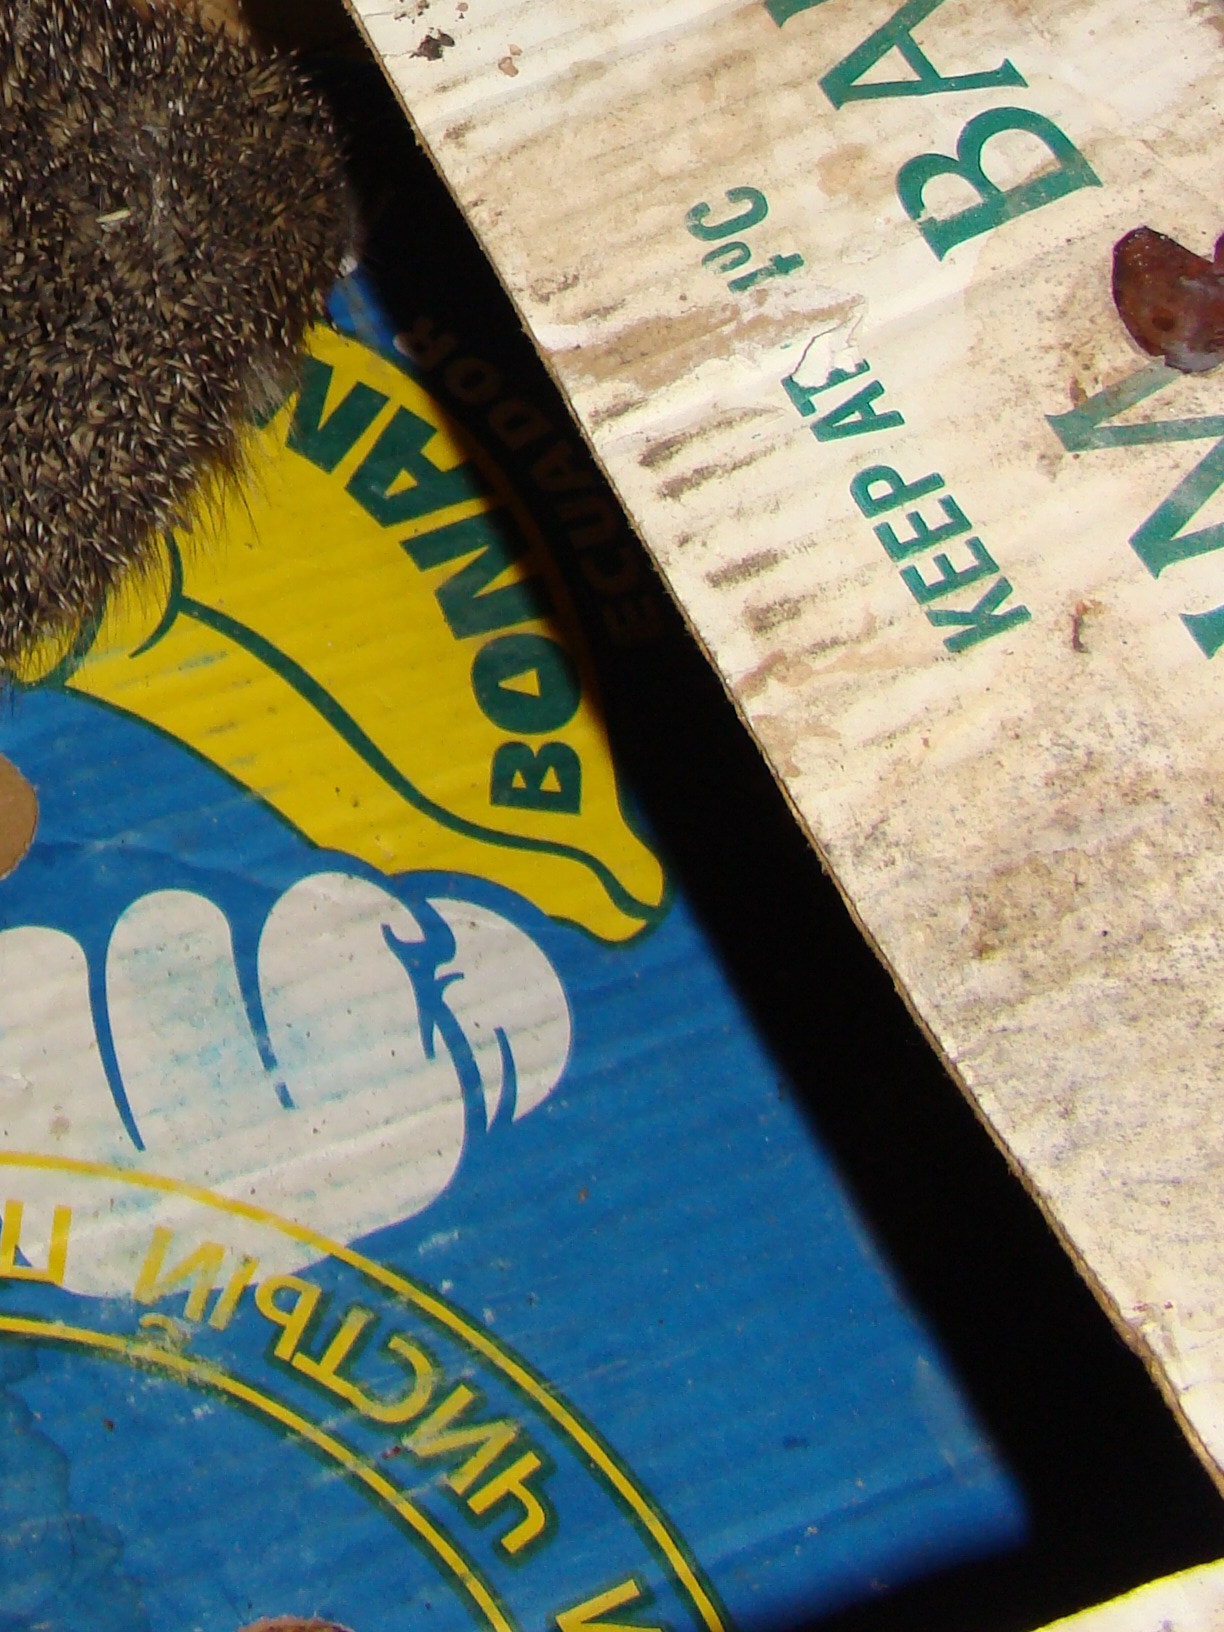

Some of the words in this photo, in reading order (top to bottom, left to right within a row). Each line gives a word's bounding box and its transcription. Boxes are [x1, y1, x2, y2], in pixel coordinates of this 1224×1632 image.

[780, 359, 907, 443] AT
[849, 465, 1032, 654] KEEP
[132, 1227, 547, 1556] ЧИСТЫЙ
